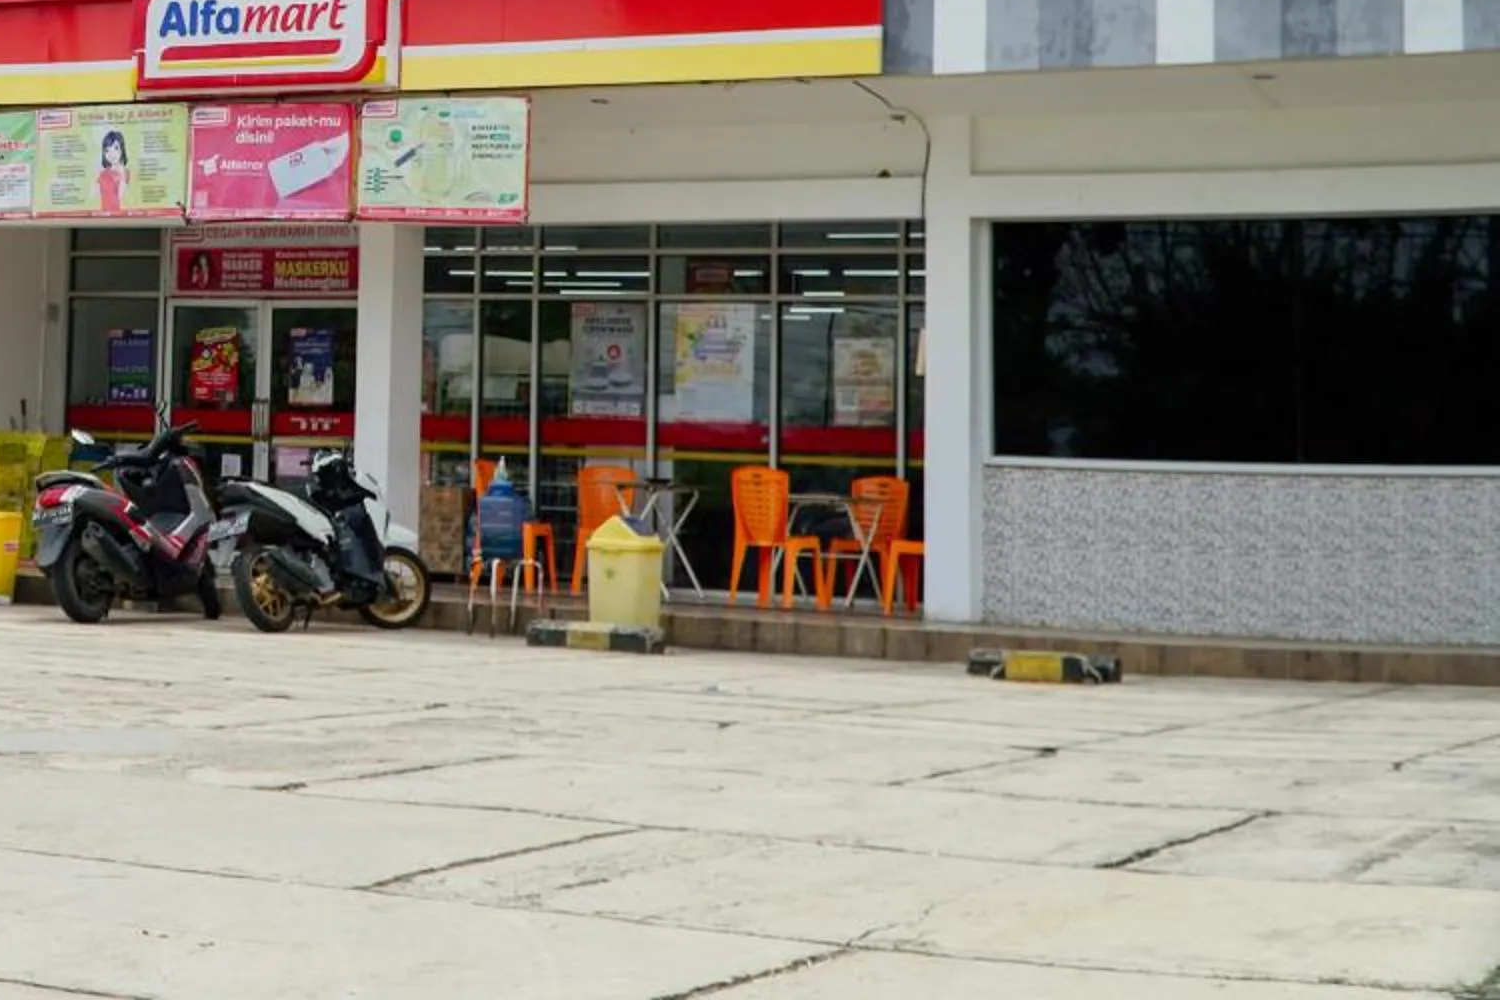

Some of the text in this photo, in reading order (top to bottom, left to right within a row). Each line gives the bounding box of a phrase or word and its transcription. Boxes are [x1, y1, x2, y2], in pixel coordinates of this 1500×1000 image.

[237, 115, 341, 129] Kirim paket-mu
[274, 260, 349, 276] MASKERKU
